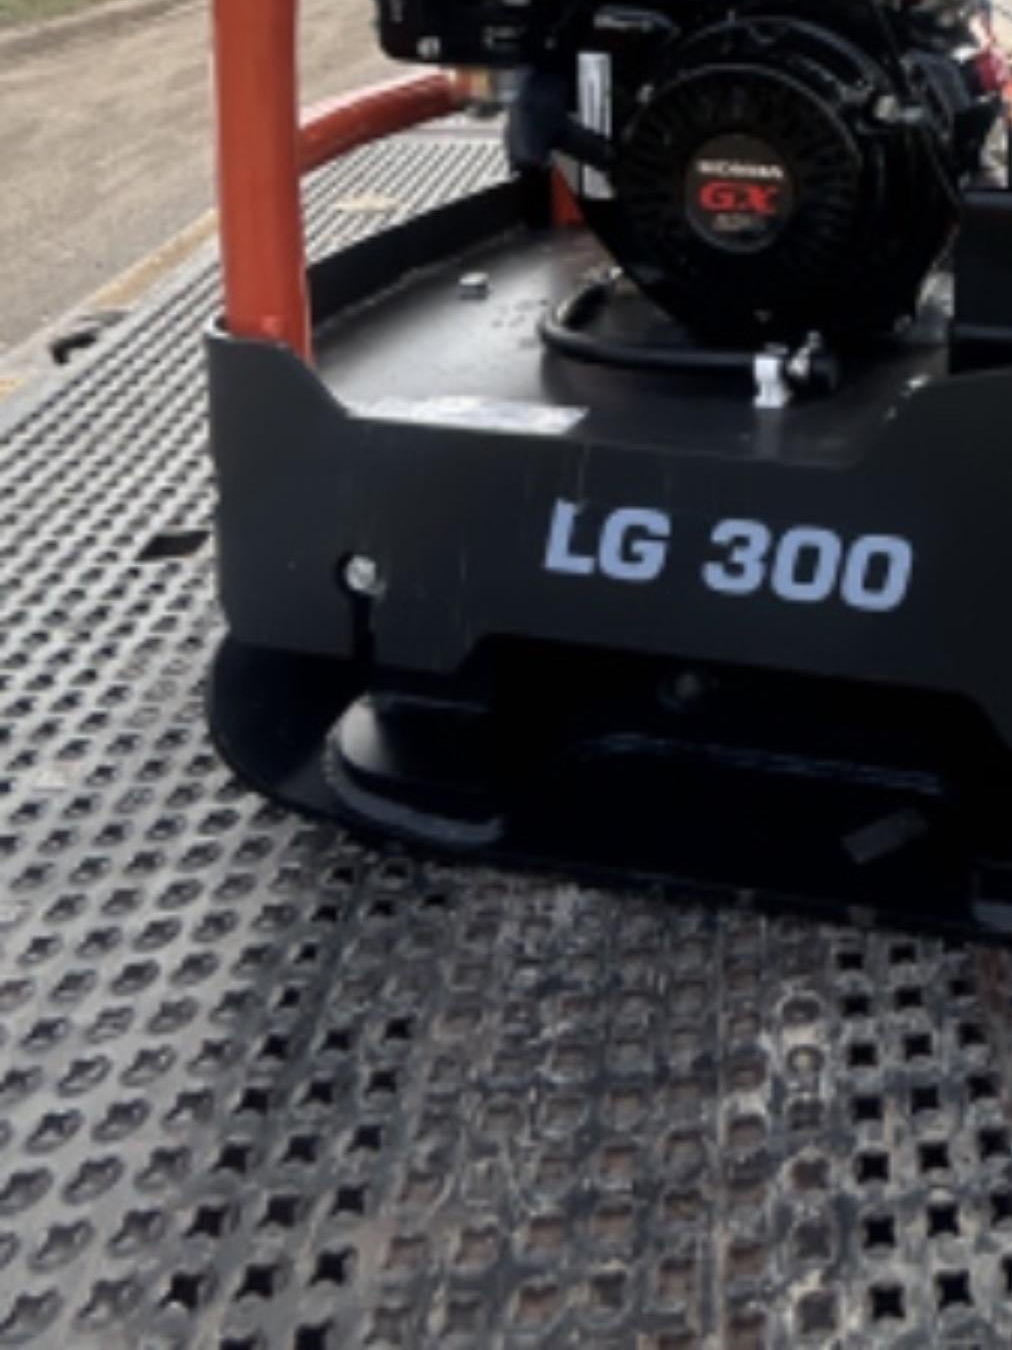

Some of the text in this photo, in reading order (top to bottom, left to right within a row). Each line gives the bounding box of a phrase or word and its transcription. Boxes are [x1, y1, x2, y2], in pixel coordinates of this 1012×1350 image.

[699, 181, 779, 216] GX
[544, 497, 914, 613] LG 300
